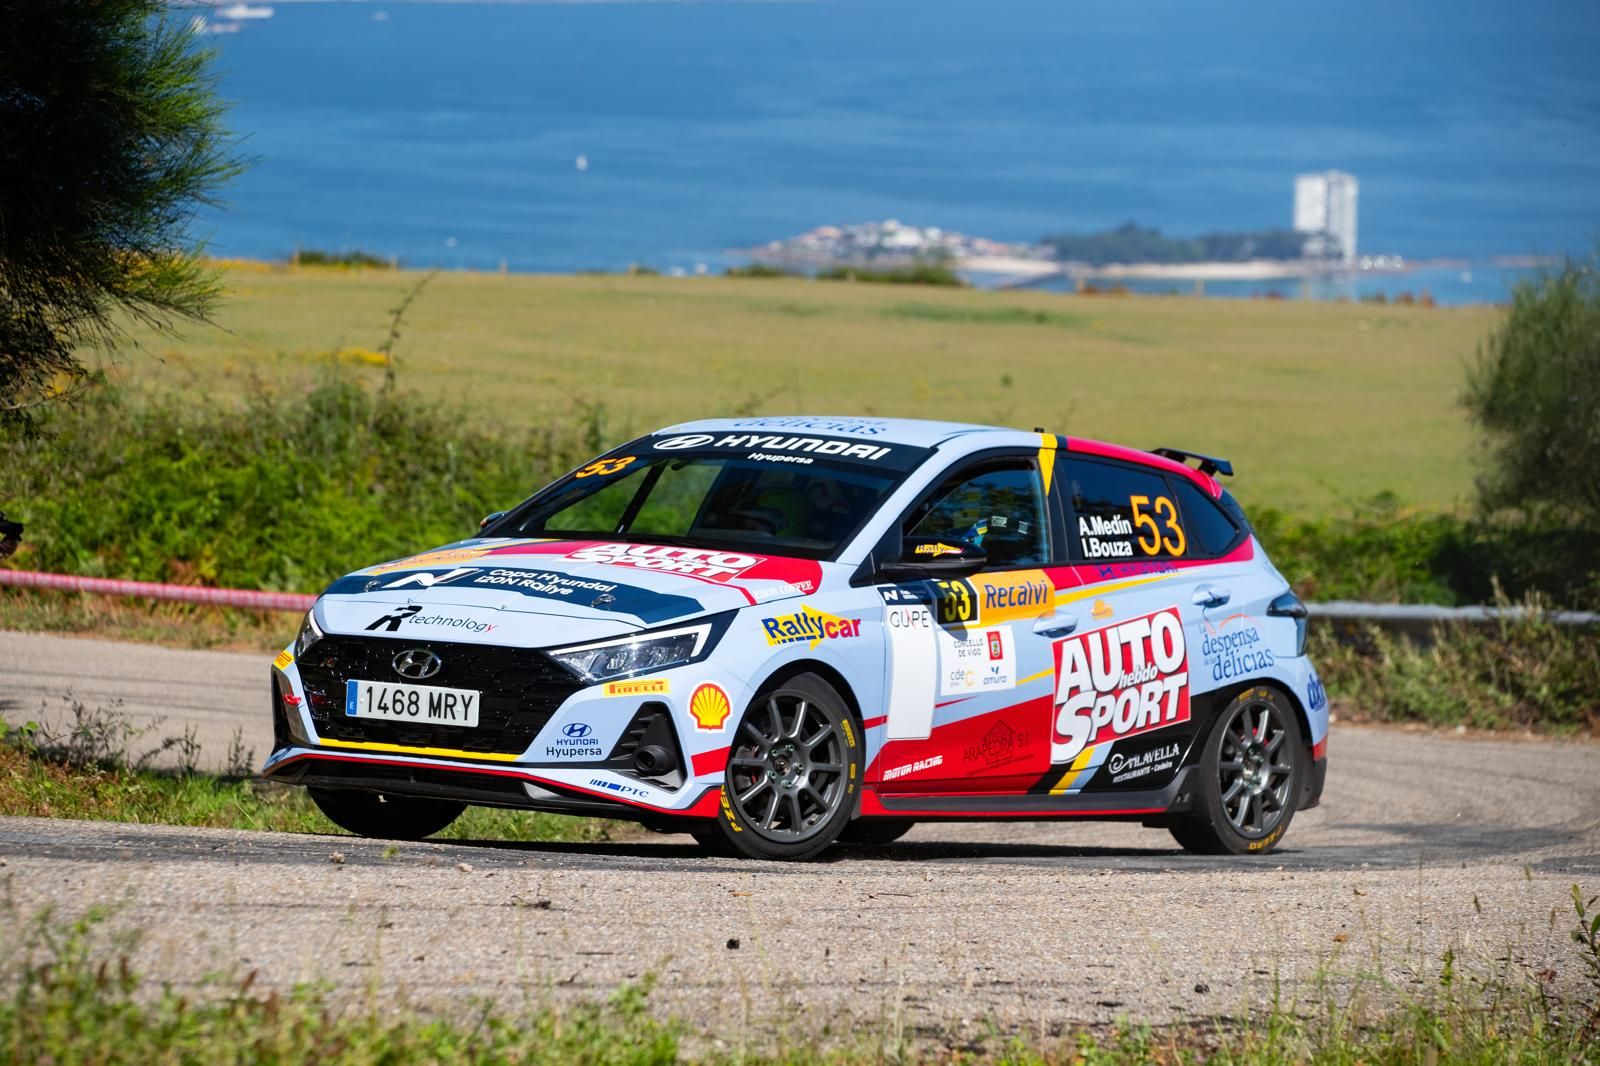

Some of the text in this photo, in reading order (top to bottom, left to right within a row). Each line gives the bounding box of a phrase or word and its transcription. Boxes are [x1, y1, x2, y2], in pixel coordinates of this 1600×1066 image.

[714, 435, 892, 460] HYUNDAI
[747, 452, 814, 464] Hyupersa
[575, 456, 637, 478] 53
[1079, 514, 1133, 536] A.Medín
[1130, 495, 1186, 557] 53
[597, 543, 757, 568] AUTO
[1081, 538, 1133, 558] I.Bouza
[557, 551, 740, 578] SPORT
[489, 569, 618, 592] Copa Hyundai
[517, 579, 574, 595] Rallye
[937, 580, 971, 622] 53
[984, 579, 1048, 609] Recalvi
[408, 613, 499, 634] technology
[761, 612, 862, 639] Rallycar
[1202, 627, 1260, 656] despensa
[1055, 611, 1186, 705] AUTO
[1213, 644, 1275, 681] delicias
[609, 681, 665, 694] PIRELLI
[1119, 661, 1158, 689] hebdo
[366, 686, 474, 721] 1468 MRY
[1051, 672, 1188, 764] SPORT
[546, 746, 602, 758] Hyupersa
[556, 738, 599, 746] HYUNDAI
[883, 754, 943, 781] MOTOR RACING
[620, 785, 649, 797] PTC
